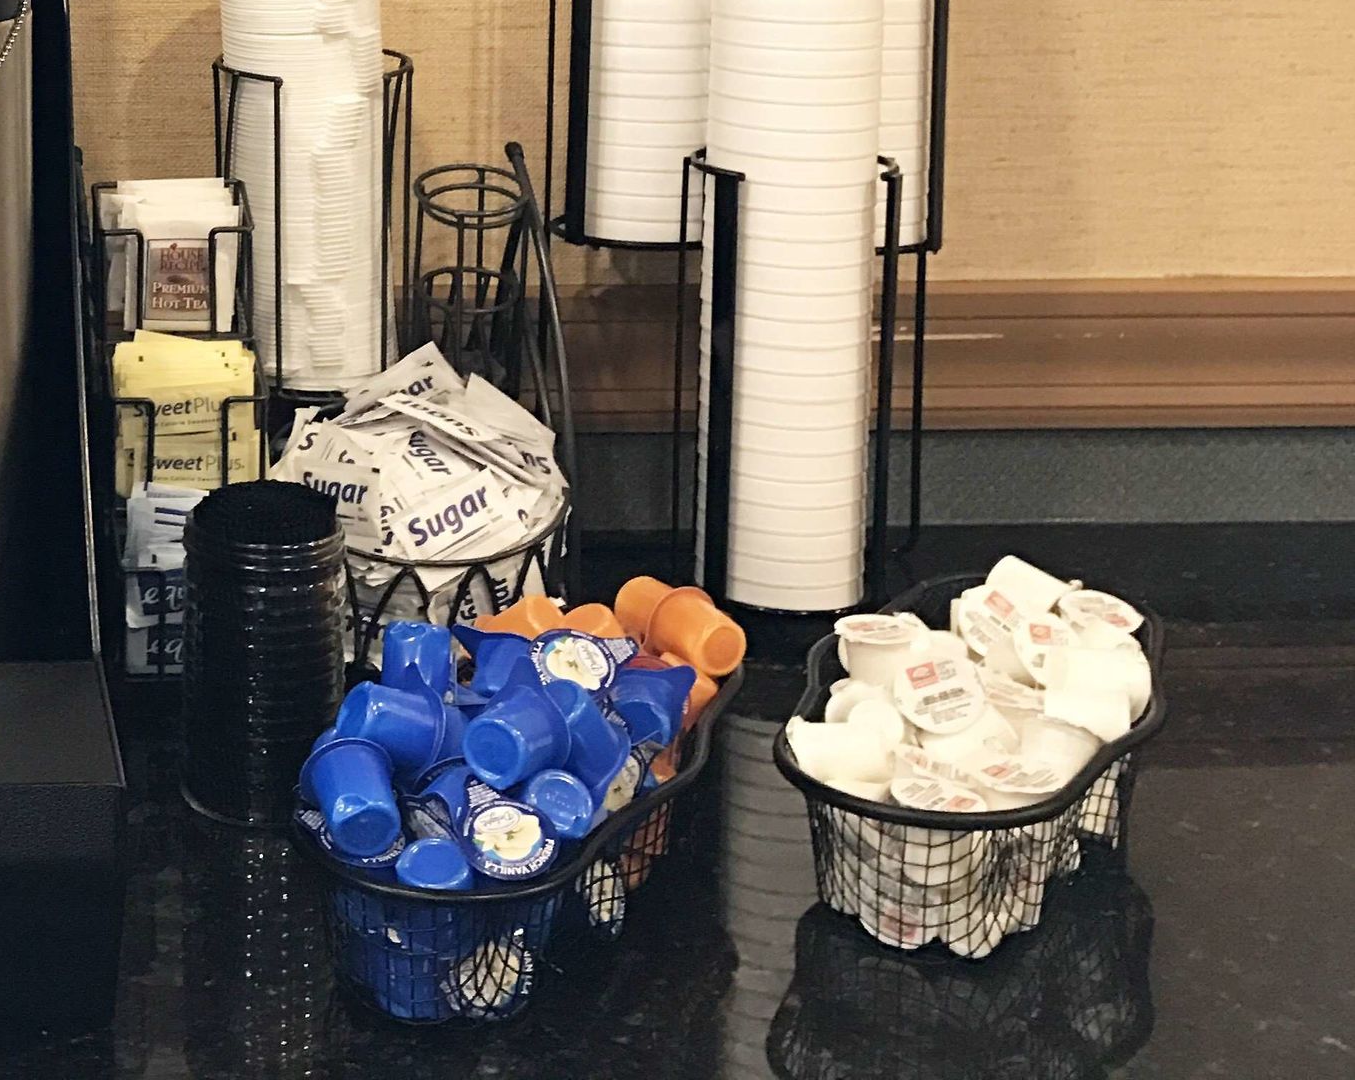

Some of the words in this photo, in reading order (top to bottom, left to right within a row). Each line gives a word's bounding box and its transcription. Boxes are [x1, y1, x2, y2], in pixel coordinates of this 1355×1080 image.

[160, 248, 204, 261] HOUSE
[152, 281, 210, 294] PREMIUM
[407, 486, 488, 547] Sugar
[484, 860, 531, 875] VANILLA
